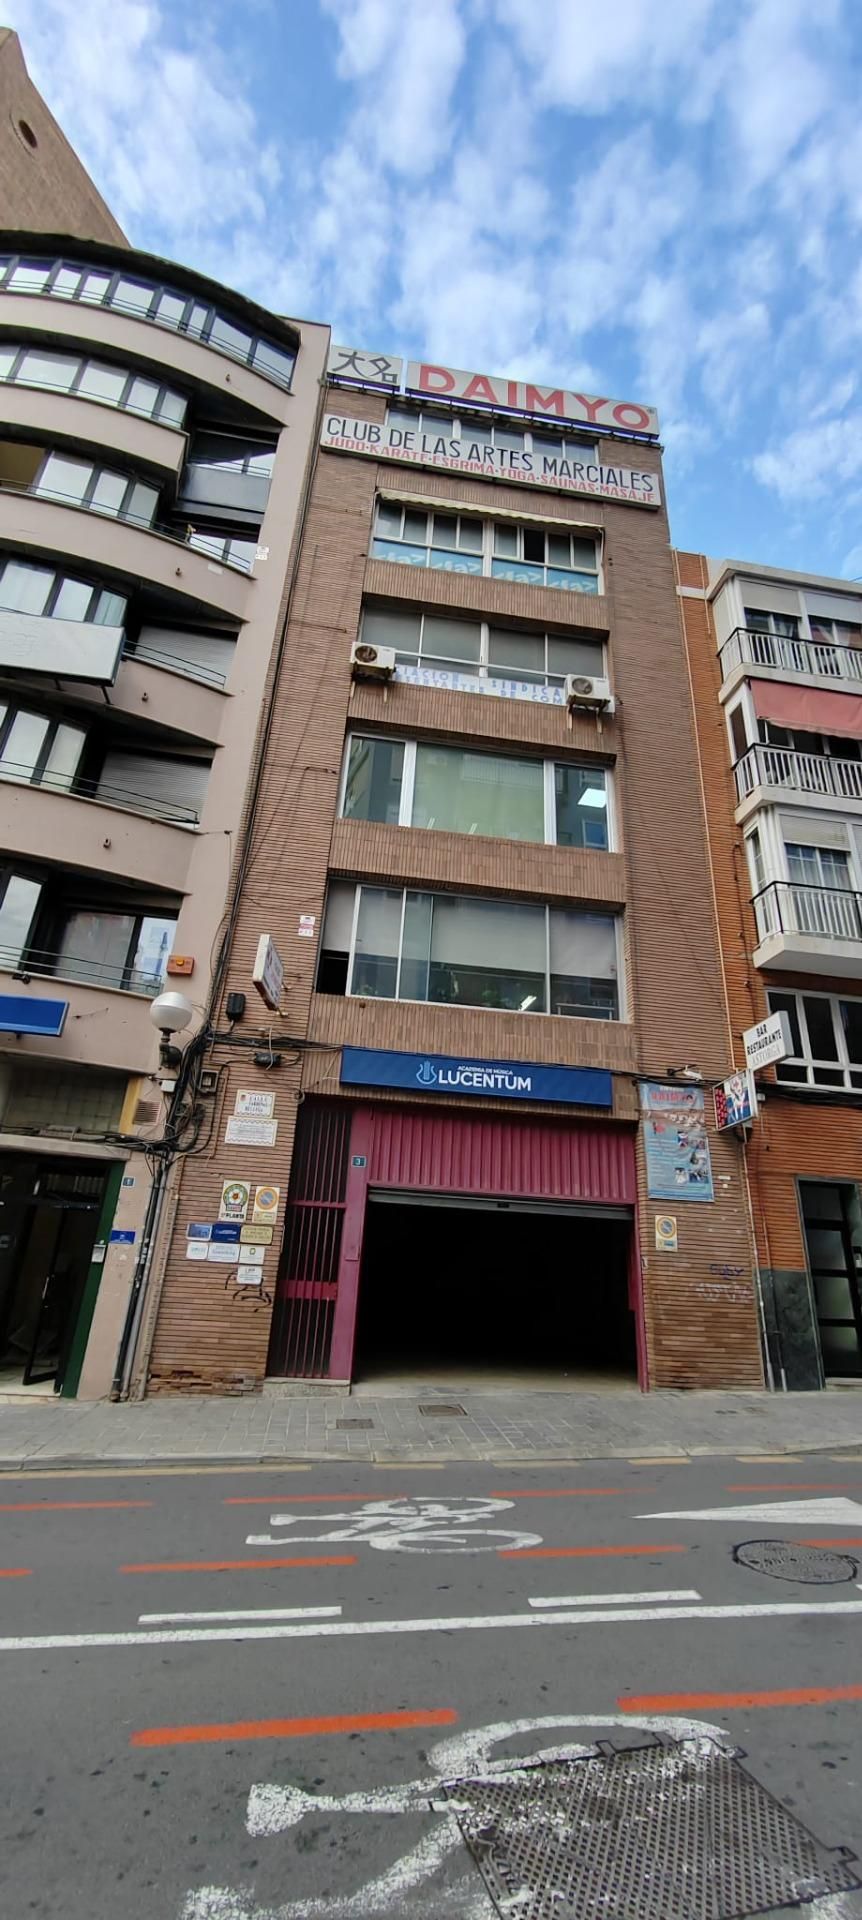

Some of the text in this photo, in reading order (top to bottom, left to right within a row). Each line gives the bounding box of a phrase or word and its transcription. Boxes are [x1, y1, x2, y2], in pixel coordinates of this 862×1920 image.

[331, 351, 398, 384] 大名
[419, 364, 650, 430] DAIMYO
[327, 417, 654, 492] CLUB DE LAS ARTES MARCIALES
[600, 486, 655, 503] MASAJE
[747, 1029, 782, 1056] RESTAURANTE
[756, 1023, 767, 1037] BAR
[438, 1069, 532, 1092] LUCENTUM
